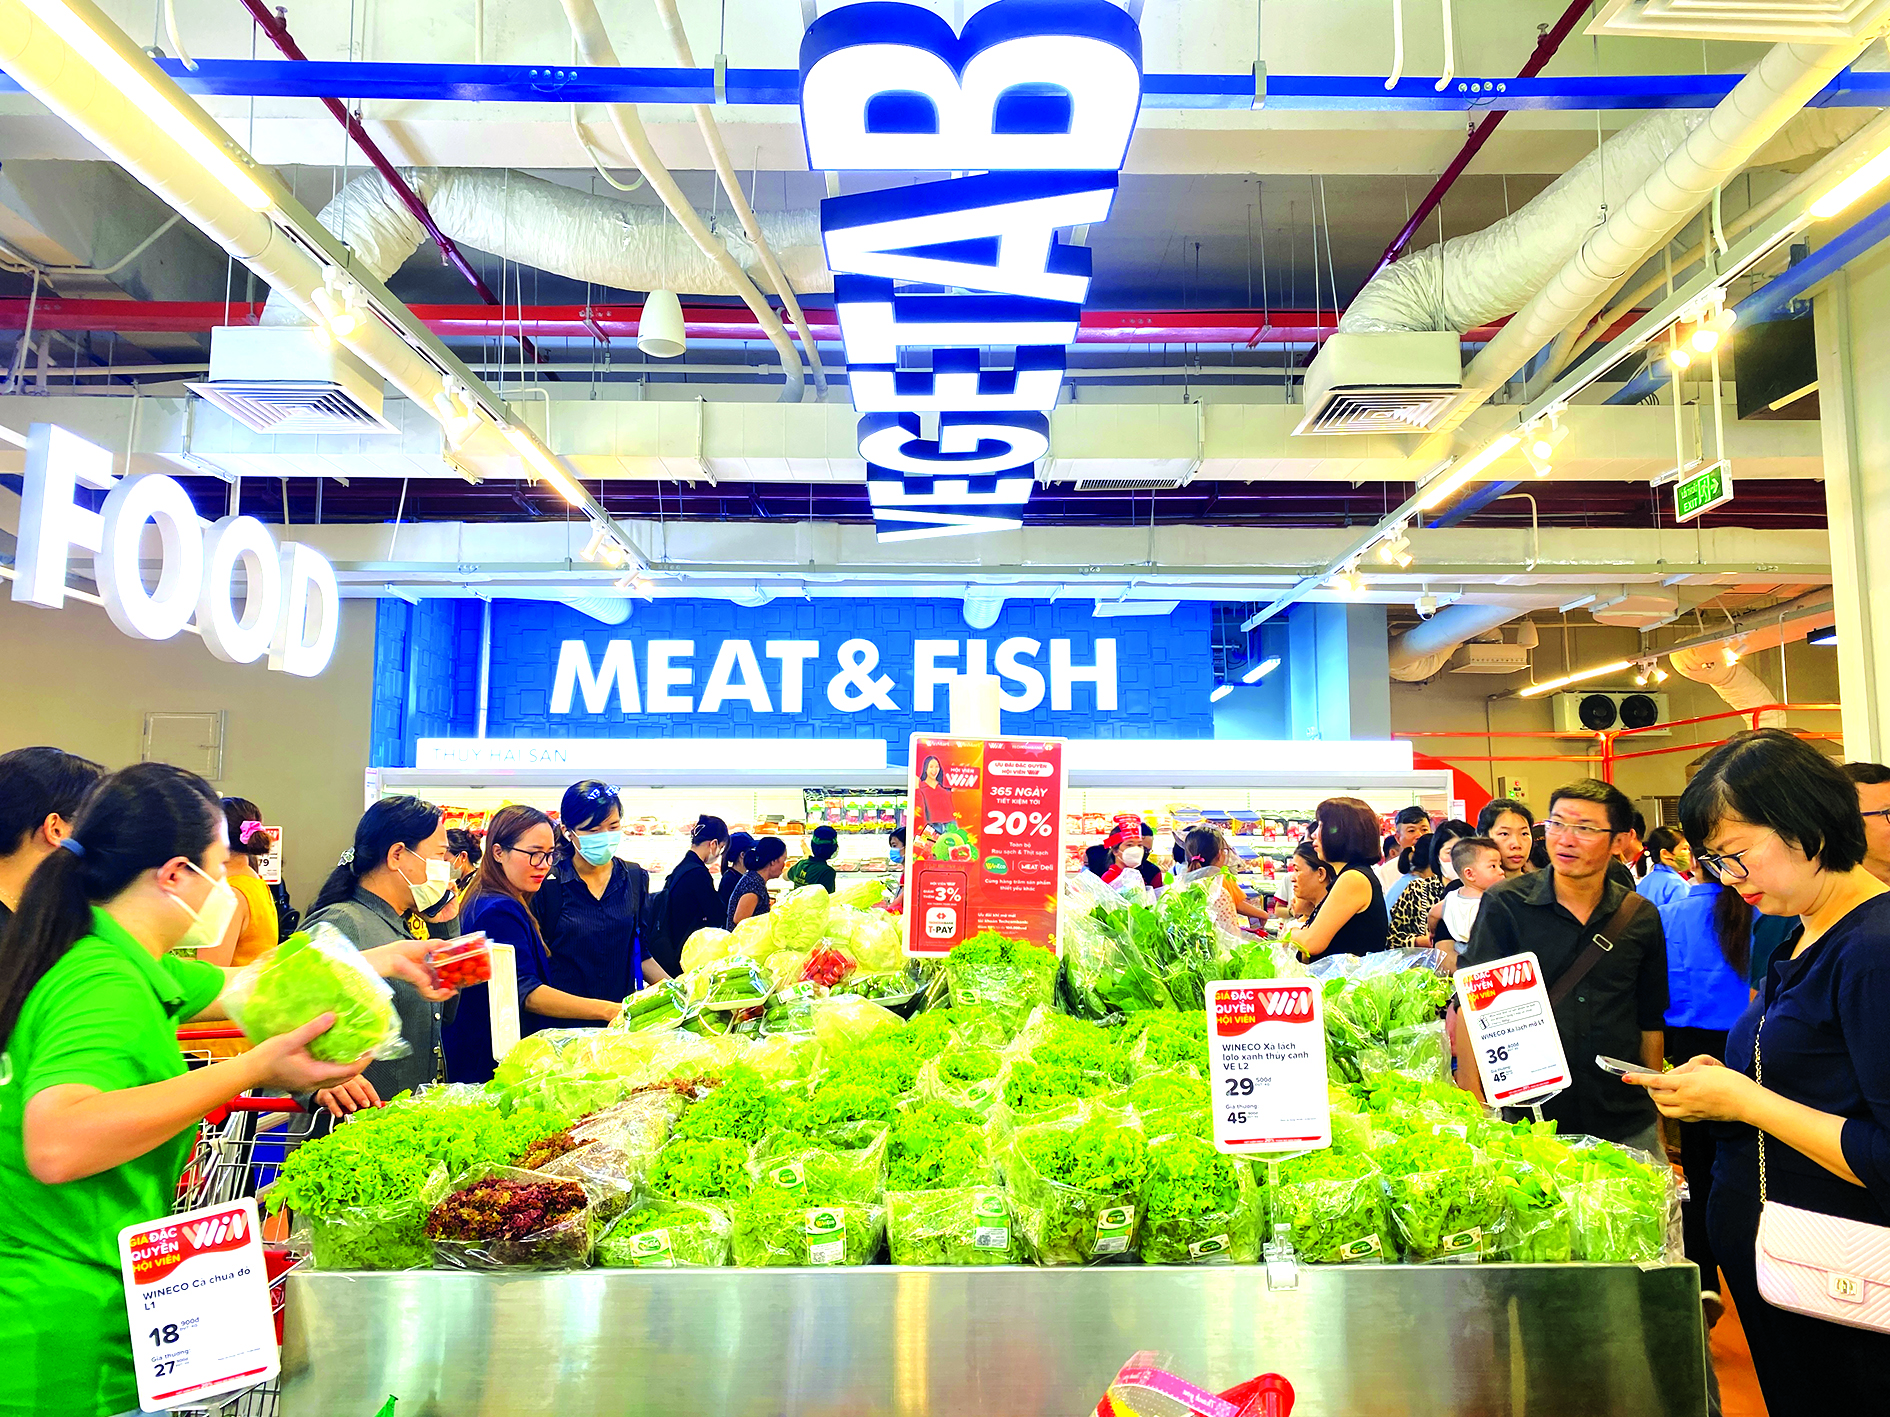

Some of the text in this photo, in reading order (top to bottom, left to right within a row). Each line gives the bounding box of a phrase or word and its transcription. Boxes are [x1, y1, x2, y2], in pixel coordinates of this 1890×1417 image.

[1683, 498, 1698, 512] EXIT
[12, 422, 340, 679] FOOD
[549, 638, 820, 714] MEAT
[826, 636, 901, 714] &
[990, 785, 1049, 798] 365 NGÀY
[983, 810, 1053, 837] 20%
[935, 887, 962, 902] 3%
[928, 925, 954, 934] T-PAY
[1215, 990, 1231, 1001] GIÁ
[1215, 1000, 1255, 1013] QUYỀN
[1216, 1013, 1256, 1025] HỘI VIÊN
[1222, 1042, 1261, 1051] WINECO
[1241, 1052, 1264, 1061] xanh
[1485, 1046, 1509, 1065] 36
[1238, 1062, 1250, 1071] L2
[1493, 1071, 1507, 1083] 45
[1225, 1077, 1255, 1097] 29
[1227, 1111, 1247, 1124] 45
[129, 1227, 178, 1248] GIÁ ĐẶC
[131, 1239, 179, 1262] QUYỀN
[132, 1252, 181, 1273] HỘI VIÊN
[142, 1282, 189, 1301] WINECO
[209, 1271, 235, 1284] chua
[144, 1300, 156, 1311] L1
[149, 1323, 180, 1347] 18
[154, 1360, 176, 1378] 27
